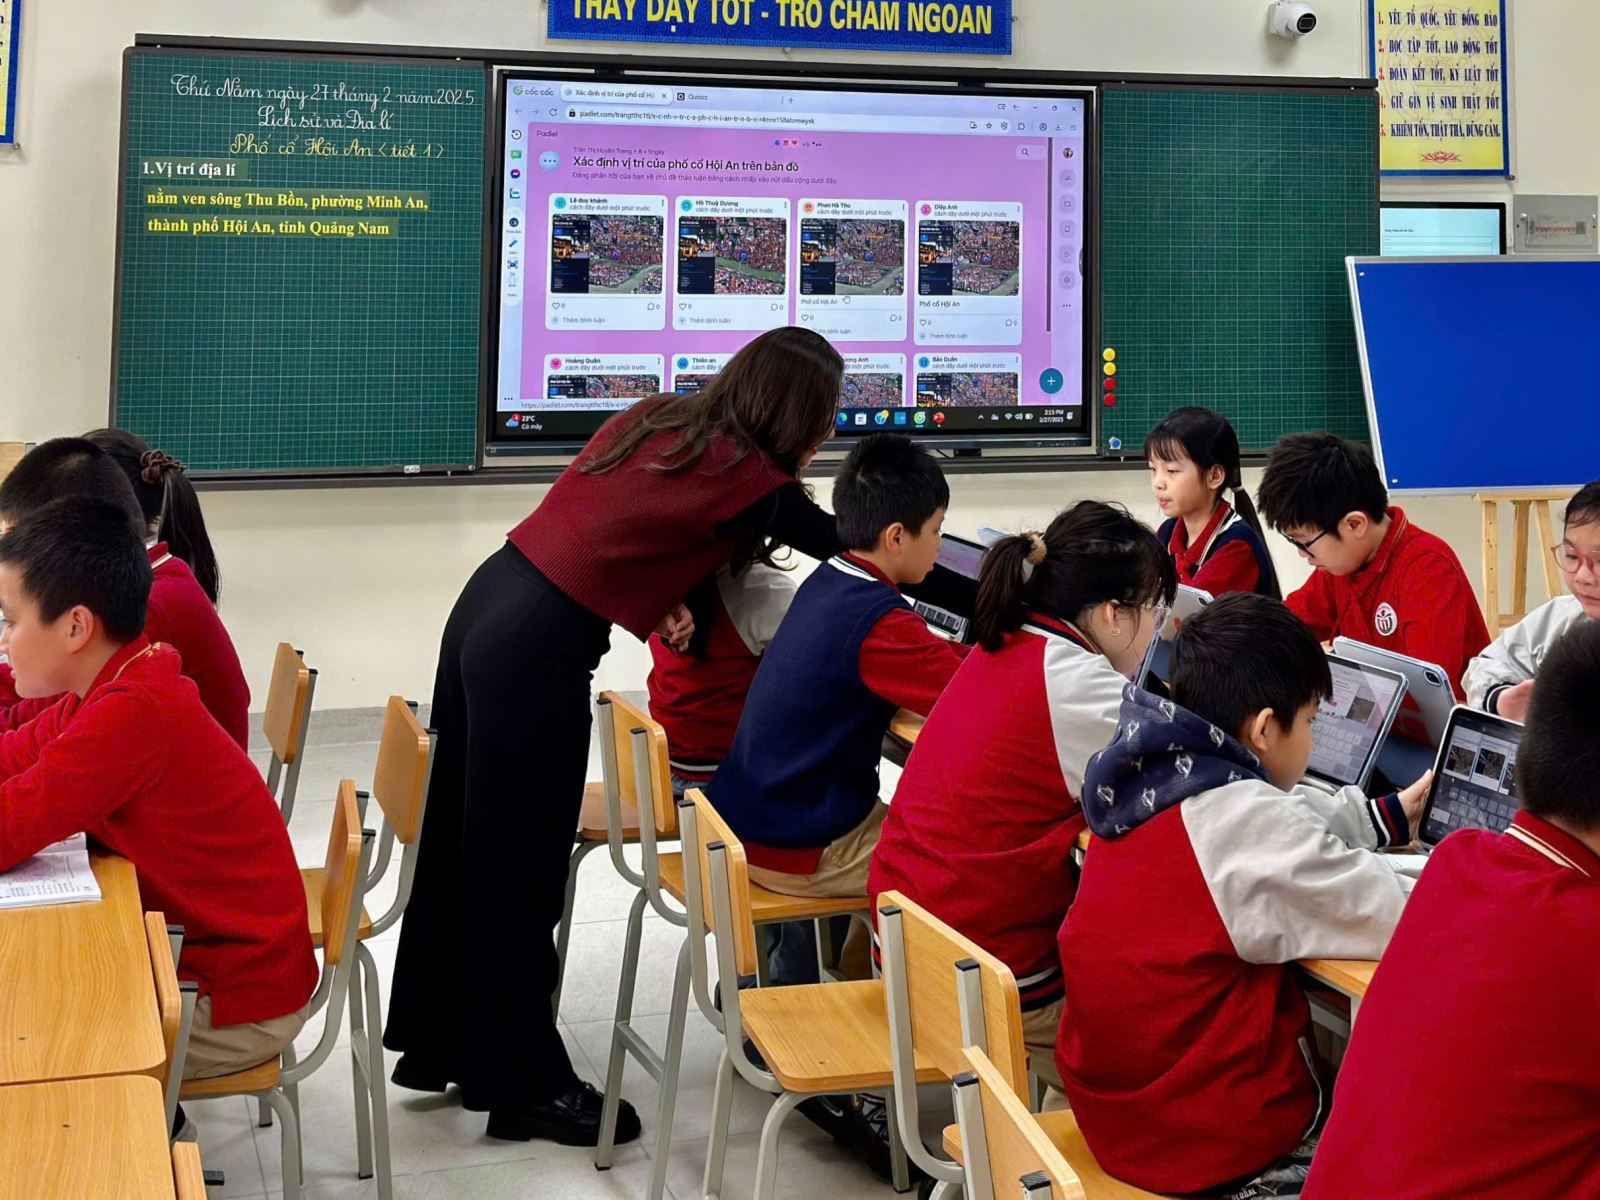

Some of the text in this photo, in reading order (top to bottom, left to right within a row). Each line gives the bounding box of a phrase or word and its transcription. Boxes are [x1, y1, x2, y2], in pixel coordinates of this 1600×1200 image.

[907, 2, 992, 34] NGOAN
[171, 73, 211, 97] Thứ
[216, 77, 263, 98] Năm
[267, 86, 308, 110] ngày
[310, 84, 331, 101] 27
[333, 81, 379, 113] tháng
[383, 86, 392, 102] 2
[257, 105, 394, 132] Lịch sử và Địa lí
[230, 133, 271, 154] Phố
[278, 134, 299, 154] cổ
[305, 137, 337, 159] Hội
[343, 138, 373, 157] An
[143, 161, 236, 179] 1.Vị trí địa lí
[573, 155, 799, 172] Xác định vị trí của phố cổ Hội An trên bản đồ
[147, 187, 429, 211] nằm ven sông Thu Bồn, phường Minh An,
[148, 218, 189, 232] thành
[192, 216, 219, 236] phố
[223, 219, 248, 236] Hội
[251, 220, 275, 235] An,
[309, 221, 355, 237] Quảng
[358, 222, 390, 235] Nam
